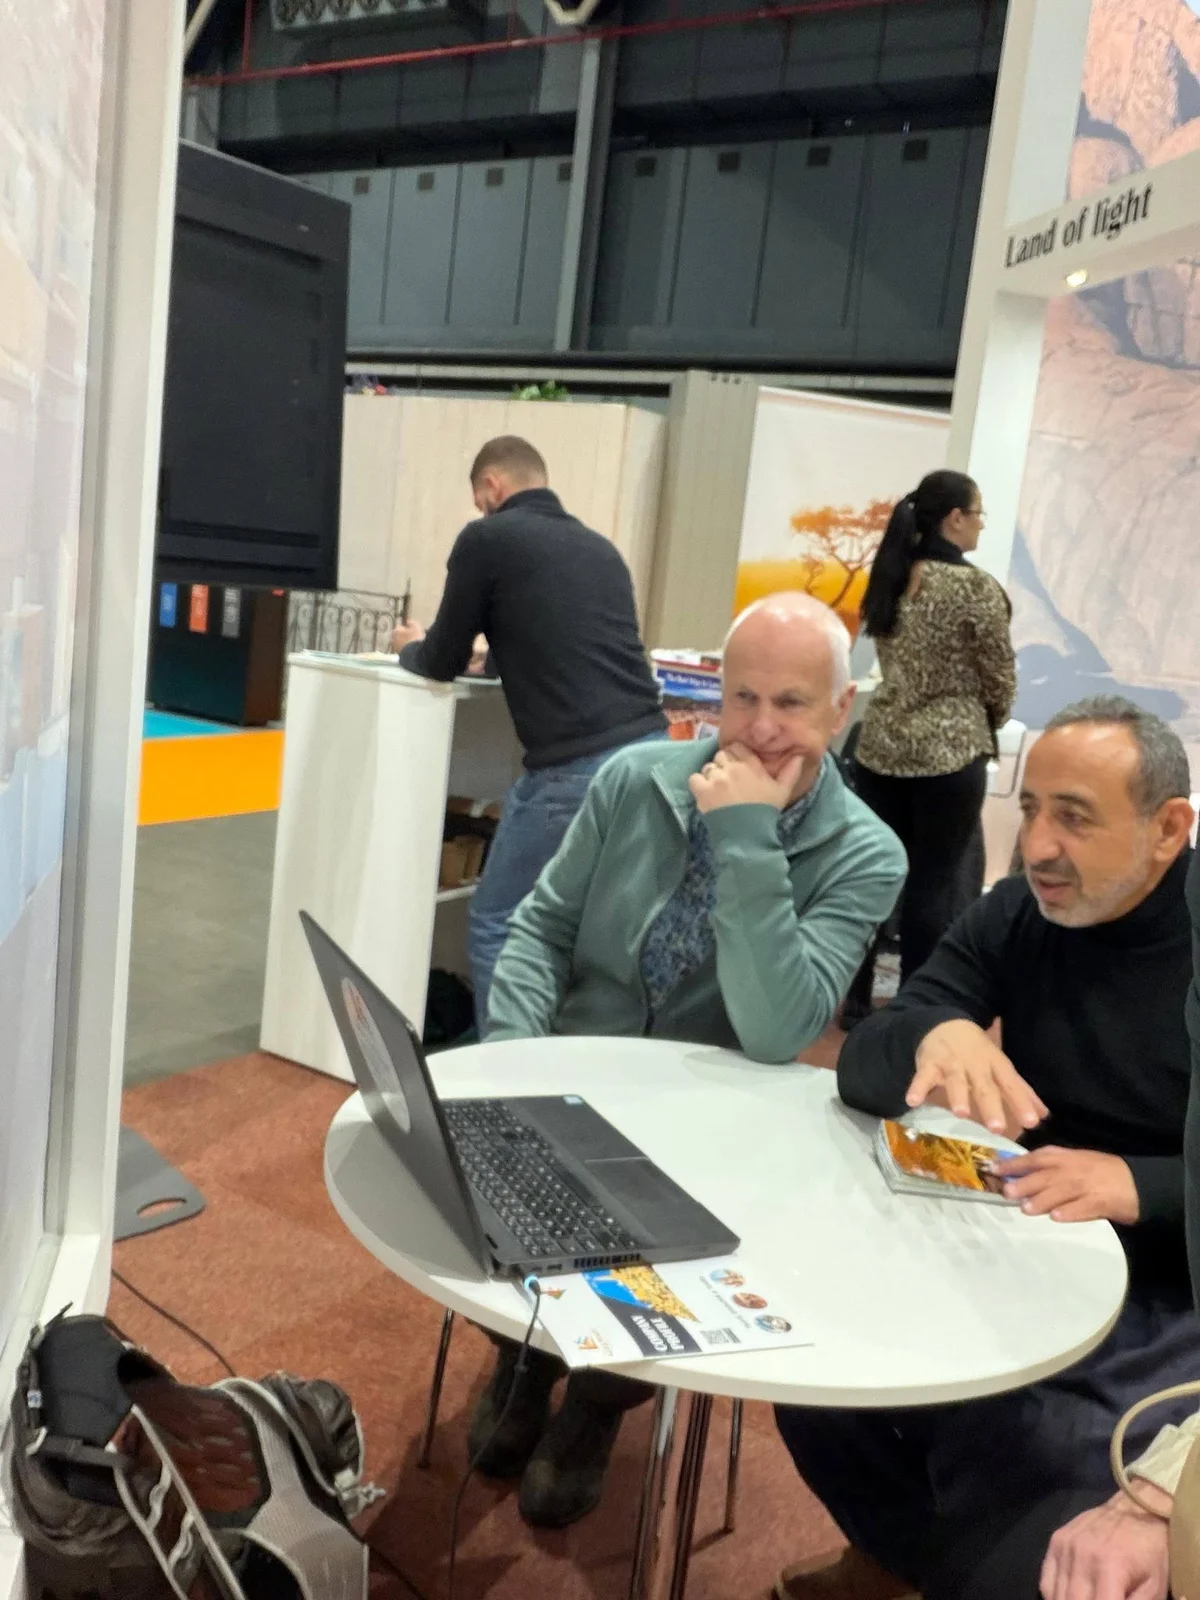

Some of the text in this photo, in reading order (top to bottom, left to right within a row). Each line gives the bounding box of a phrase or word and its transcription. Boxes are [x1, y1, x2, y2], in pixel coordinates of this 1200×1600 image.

[1005, 182, 1153, 269] Land of light
[631, 1315, 668, 1352] COMPANY
